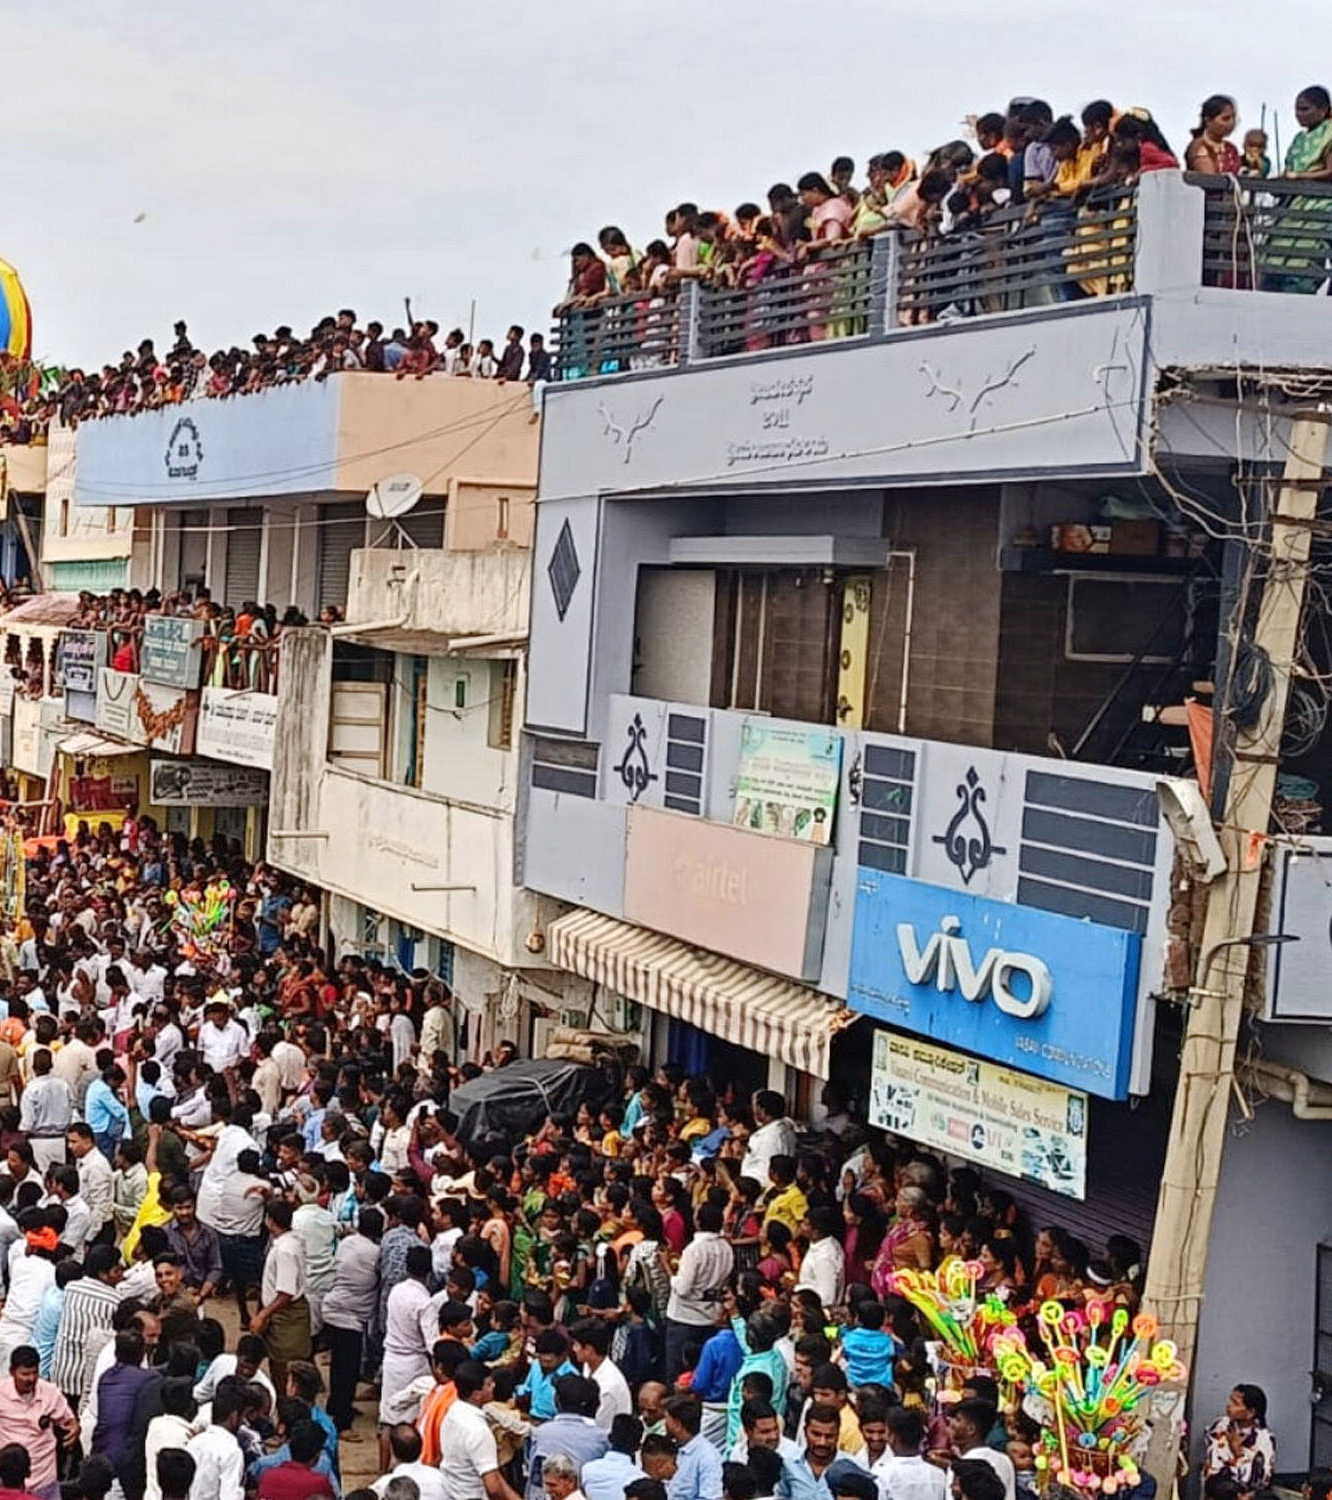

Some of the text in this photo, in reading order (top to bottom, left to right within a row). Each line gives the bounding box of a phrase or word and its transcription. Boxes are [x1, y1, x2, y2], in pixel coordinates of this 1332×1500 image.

[692, 853, 748, 905] airtel
[896, 915, 1053, 1018] vivo
[982, 1089, 1008, 1115] Mobile
[1010, 1099, 1032, 1121] Sales
[1034, 1107, 1063, 1131] Service
